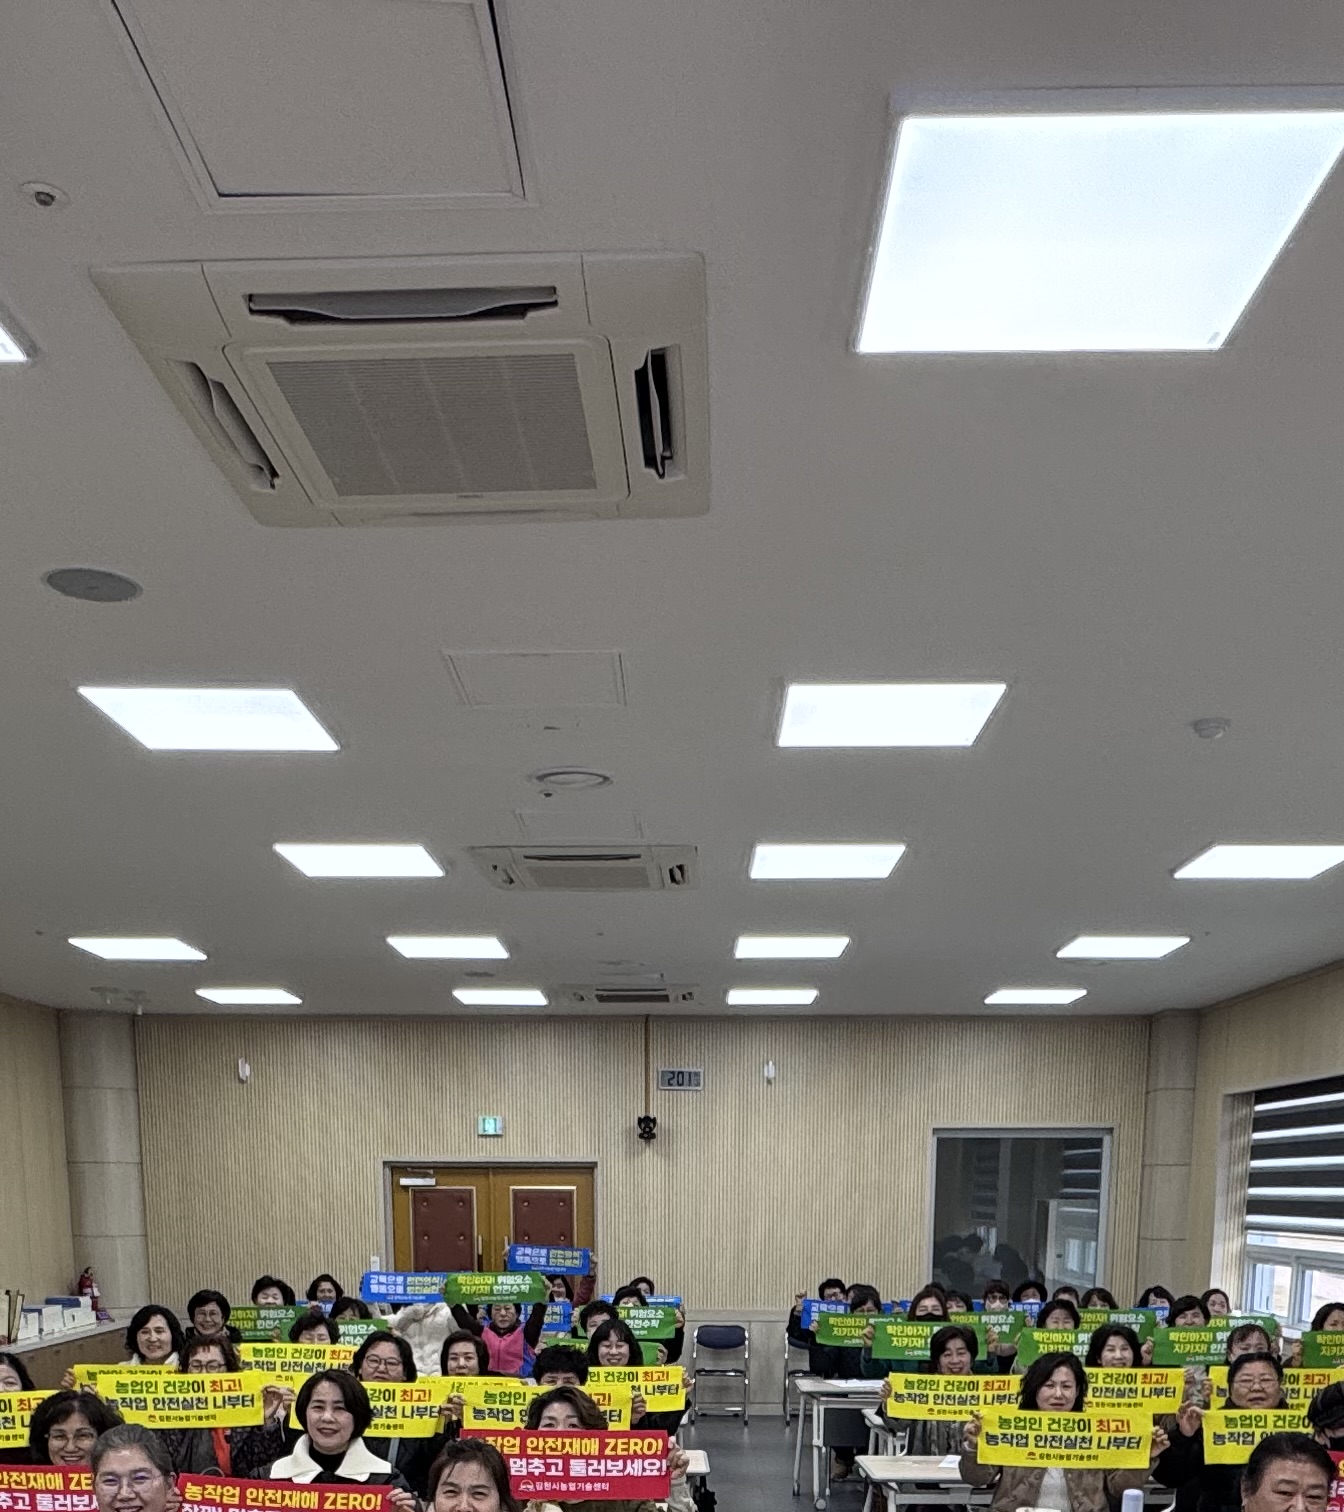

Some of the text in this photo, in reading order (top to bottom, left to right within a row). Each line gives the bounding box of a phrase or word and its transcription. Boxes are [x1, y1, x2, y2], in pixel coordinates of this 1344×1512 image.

[291, 1348, 326, 1359] 건강이
[604, 1370, 638, 1382] 건강이
[642, 1370, 669, 1382] 최고!
[1102, 1373, 1137, 1385] 건강이
[1141, 1373, 1168, 1385] 최고!
[115, 1378, 243, 1395] 농업인 건강이 최고!
[644, 1384, 679, 1396] 나부터
[904, 1378, 1011, 1392] 농업인 건강이 최고!
[1092, 1386, 1176, 1399] 안전실천 나부터
[152, 1395, 208, 1411] 안전실천
[213, 1394, 255, 1409] 나부터
[400, 1388, 432, 1403] 최고!
[484, 1390, 526, 1405] 농업인
[894, 1391, 929, 1404] 농작업
[933, 1394, 980, 1406] 안전실천
[473, 1407, 514, 1421] 농작업
[1224, 1414, 1268, 1429] 농업인
[998, 1415, 1131, 1433] 농업인 건강이 최고!
[485, 1436, 663, 1456] 작업 안전재해 ZERO!
[985, 1431, 1142, 1450] 농작업 안전실천 나부터
[1212, 1431, 1255, 1446] 농작업
[510, 1458, 667, 1477] 멈추고 둘러보세요!
[185, 1482, 382, 1510] 농작업 안전재해 ZERO!
